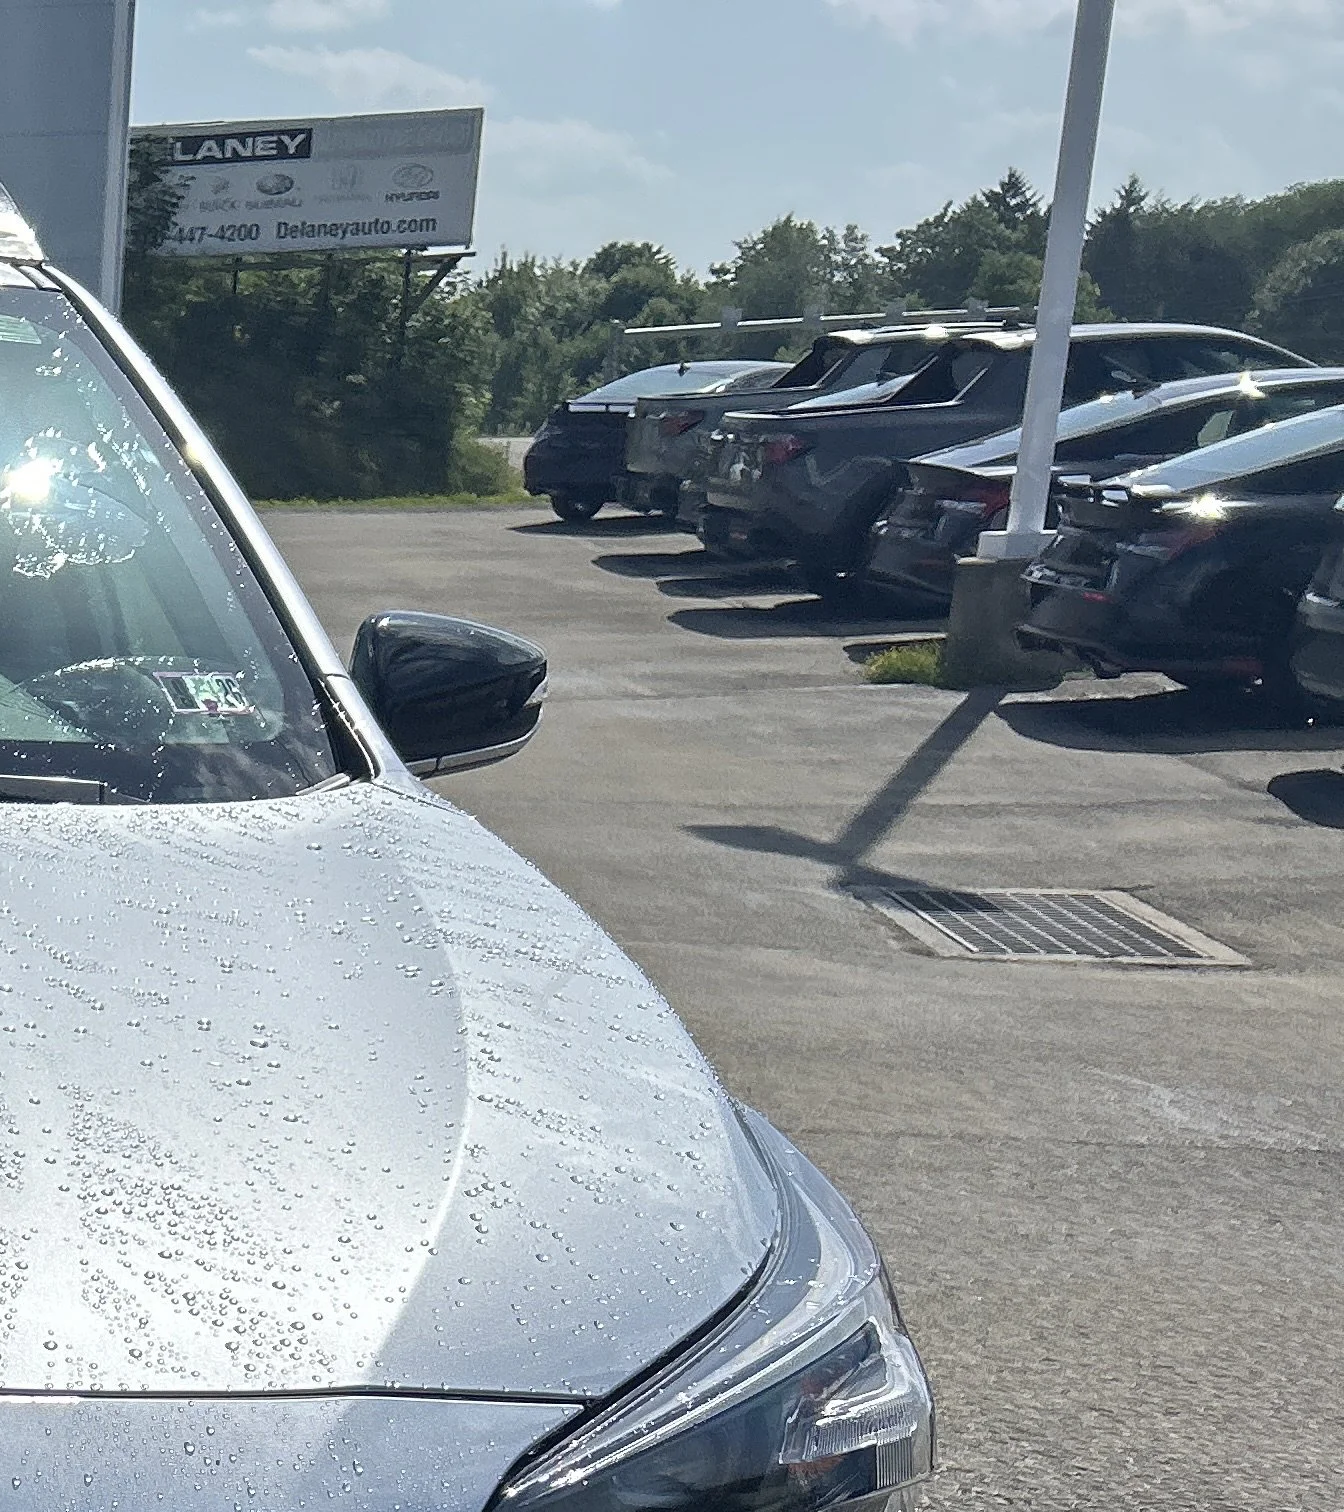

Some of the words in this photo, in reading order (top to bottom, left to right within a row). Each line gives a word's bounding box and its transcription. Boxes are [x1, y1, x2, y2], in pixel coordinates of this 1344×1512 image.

[171, 133, 307, 161] LANEY
[164, 222, 261, 245] -447-4200
[276, 216, 437, 241] Delaneyauto.com
